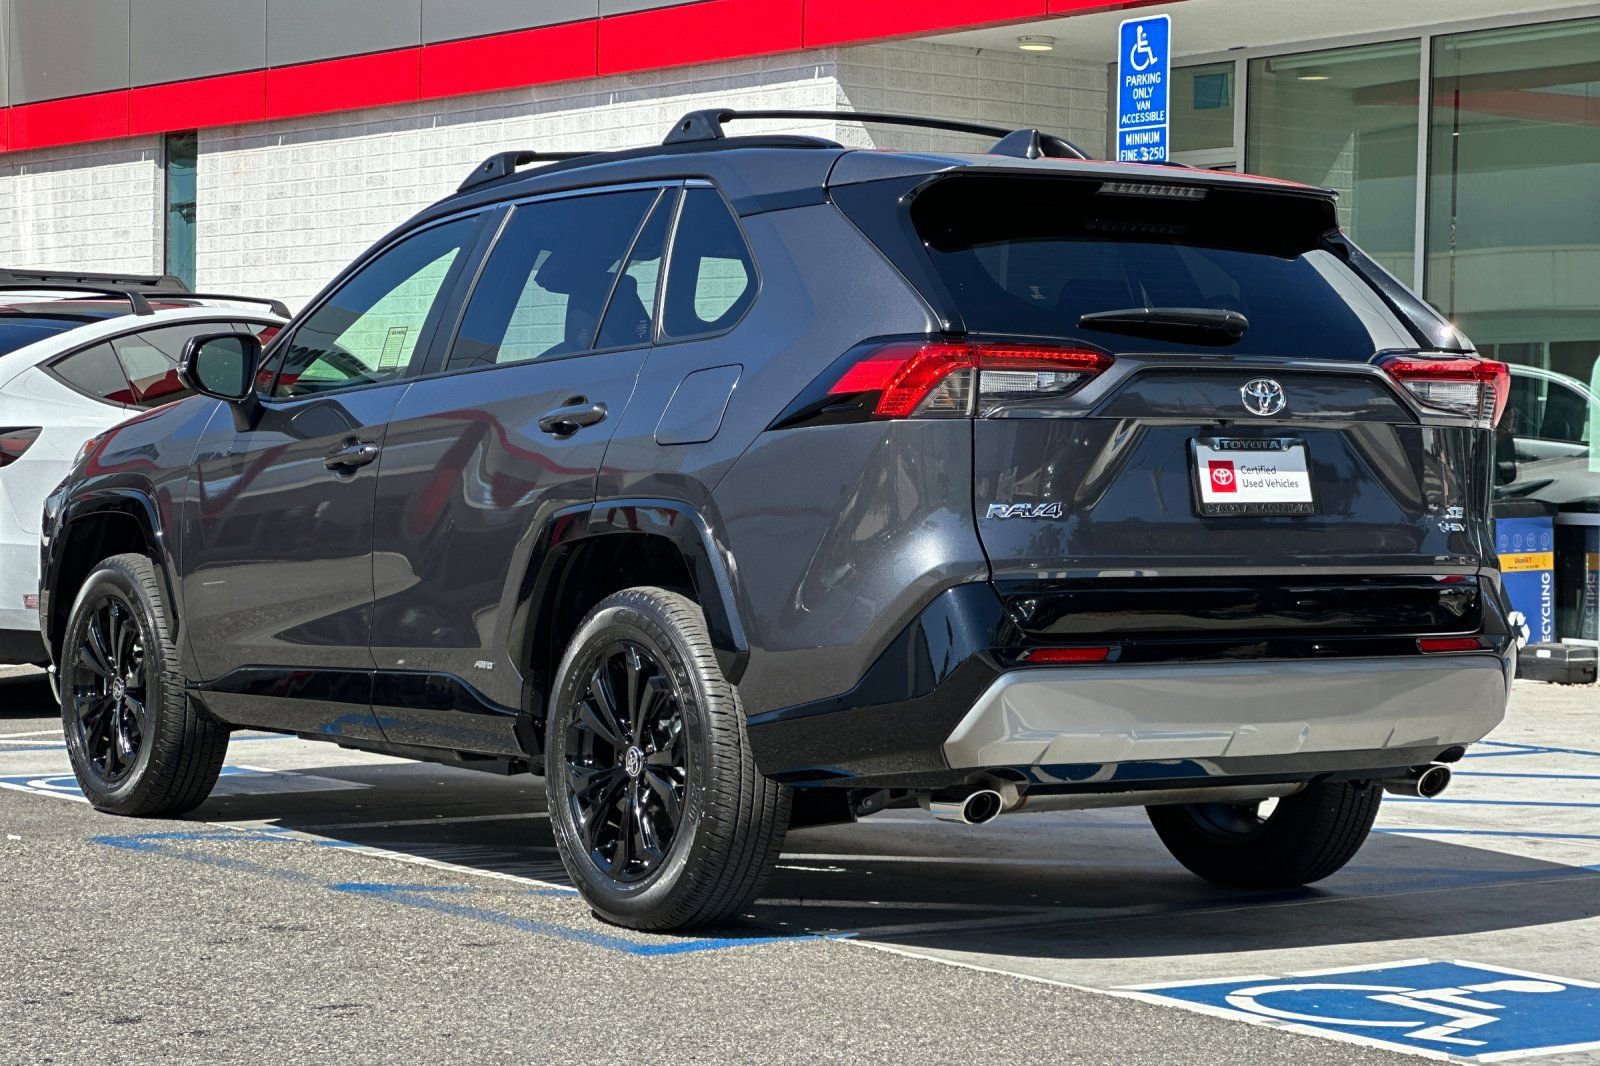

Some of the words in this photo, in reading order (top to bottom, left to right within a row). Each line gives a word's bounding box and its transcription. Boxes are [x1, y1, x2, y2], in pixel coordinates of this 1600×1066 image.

[1126, 72, 1160, 87] PARKING
[1133, 87, 1153, 99] ONLY
[1137, 100, 1150, 110] VAN
[1121, 111, 1164, 124] ACCESSIBLE
[1126, 132, 1160, 145] MINIMUM
[1120, 149, 1138, 162] FINE
[1220, 440, 1280, 449] TOYOTA
[1240, 465, 1277, 475] Certified
[1242, 479, 1263, 488] Used
[1266, 479, 1300, 488] Vehicles
[985, 502, 1063, 518] RAV4
[1541, 572, 1551, 642] ECYCLING
